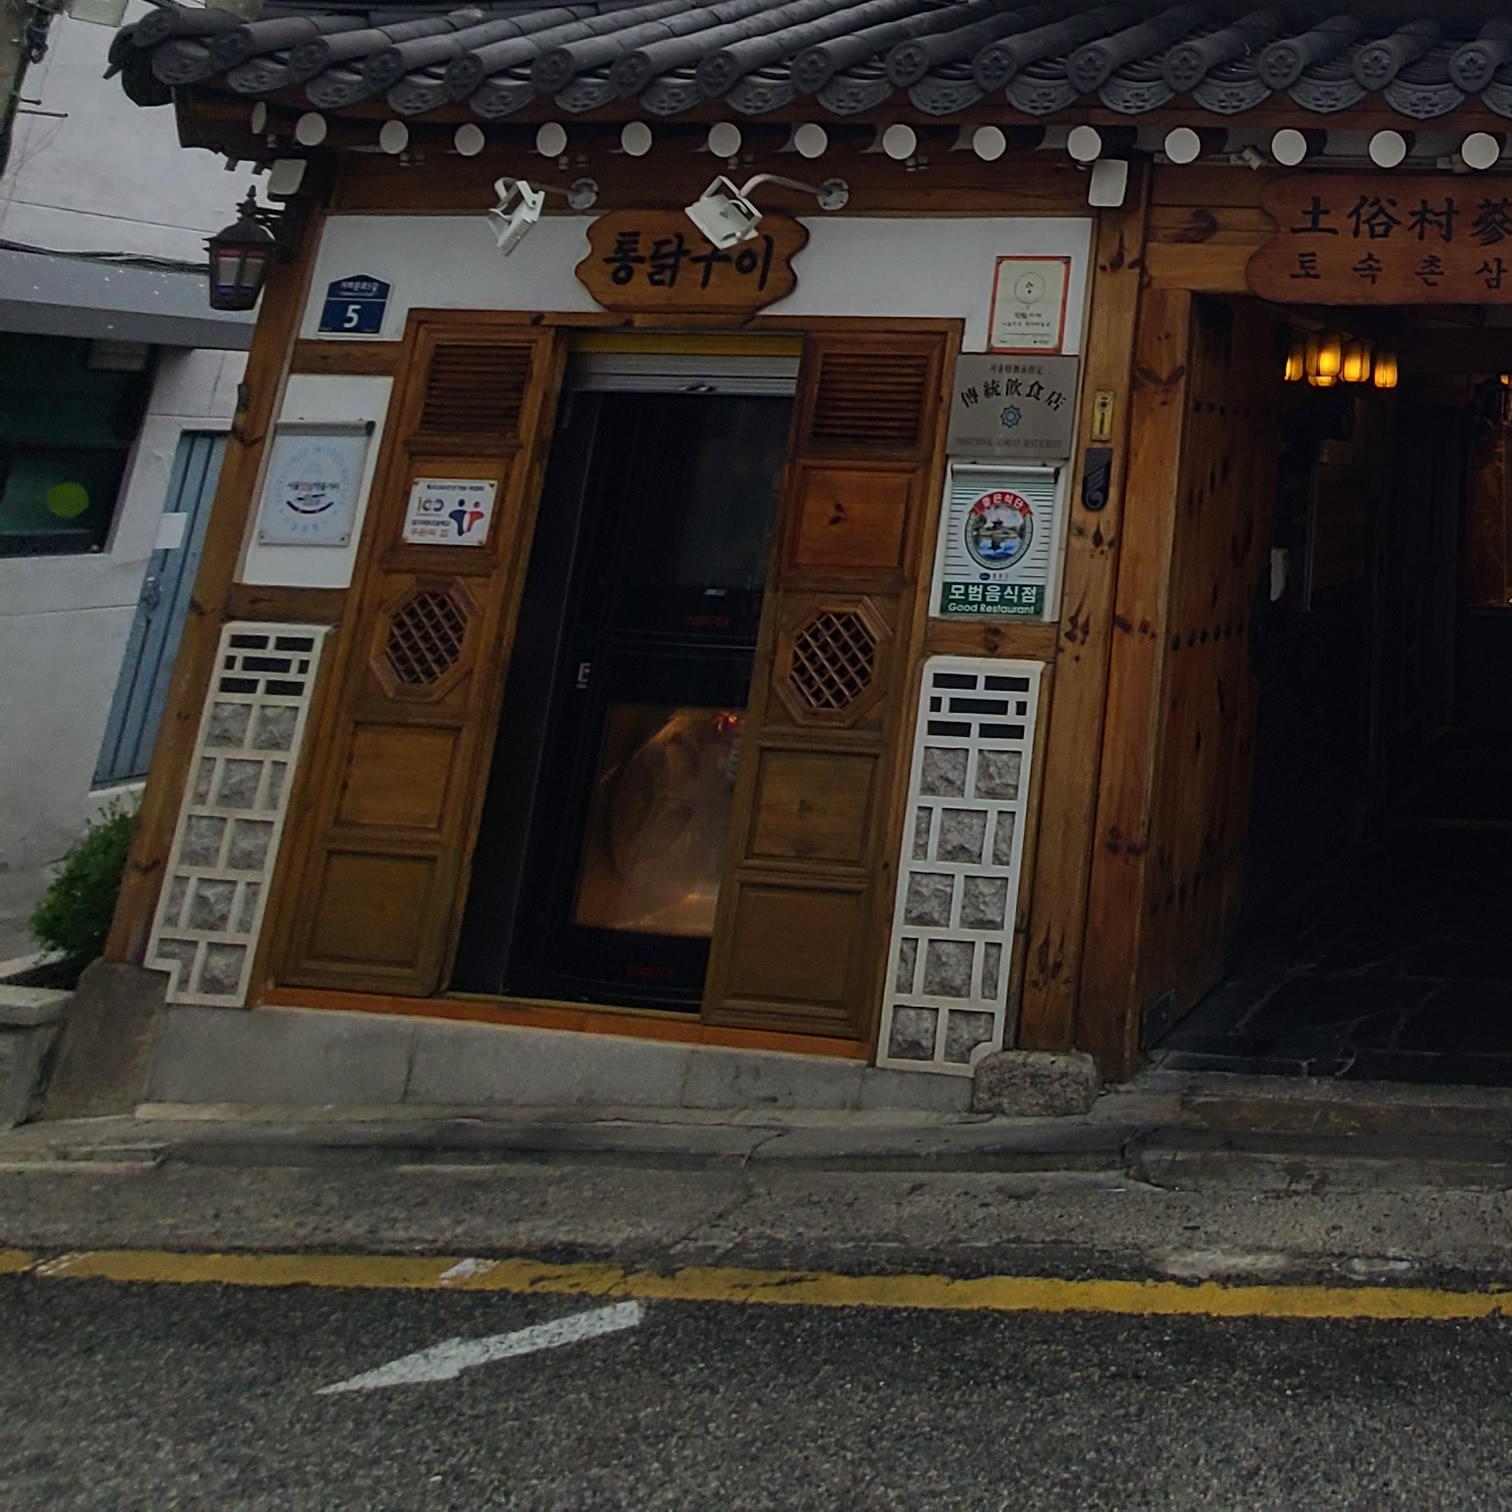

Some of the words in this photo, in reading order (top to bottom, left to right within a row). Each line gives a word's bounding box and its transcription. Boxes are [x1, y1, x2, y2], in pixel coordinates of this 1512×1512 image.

[343, 304, 362, 328] 5
[949, 584, 1037, 604] 모범음식점
[947, 602, 978, 612] Good
[980, 603, 1034, 615] Restaurant
